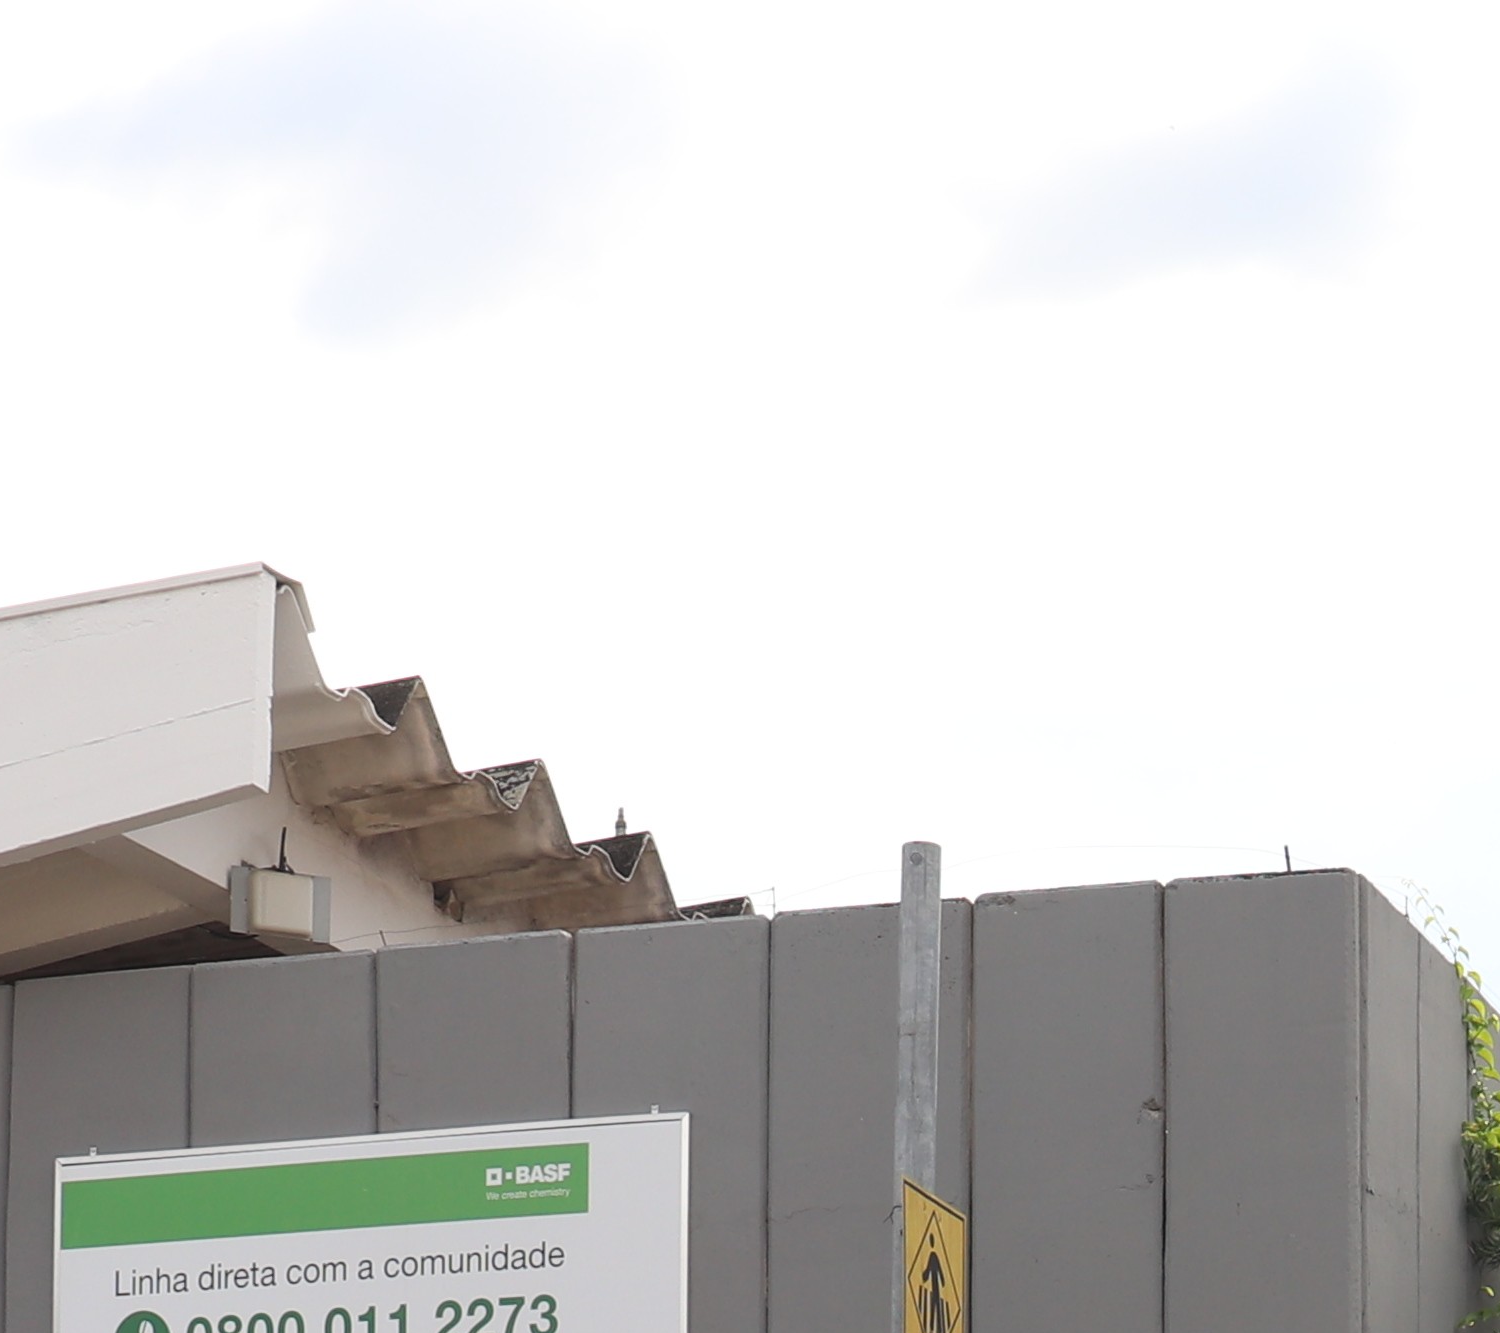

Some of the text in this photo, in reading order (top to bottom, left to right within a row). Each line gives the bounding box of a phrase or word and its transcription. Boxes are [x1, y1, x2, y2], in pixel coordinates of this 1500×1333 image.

[515, 1163, 571, 1185] BASF
[115, 1240, 565, 1297] Linha direta com a comunidade
